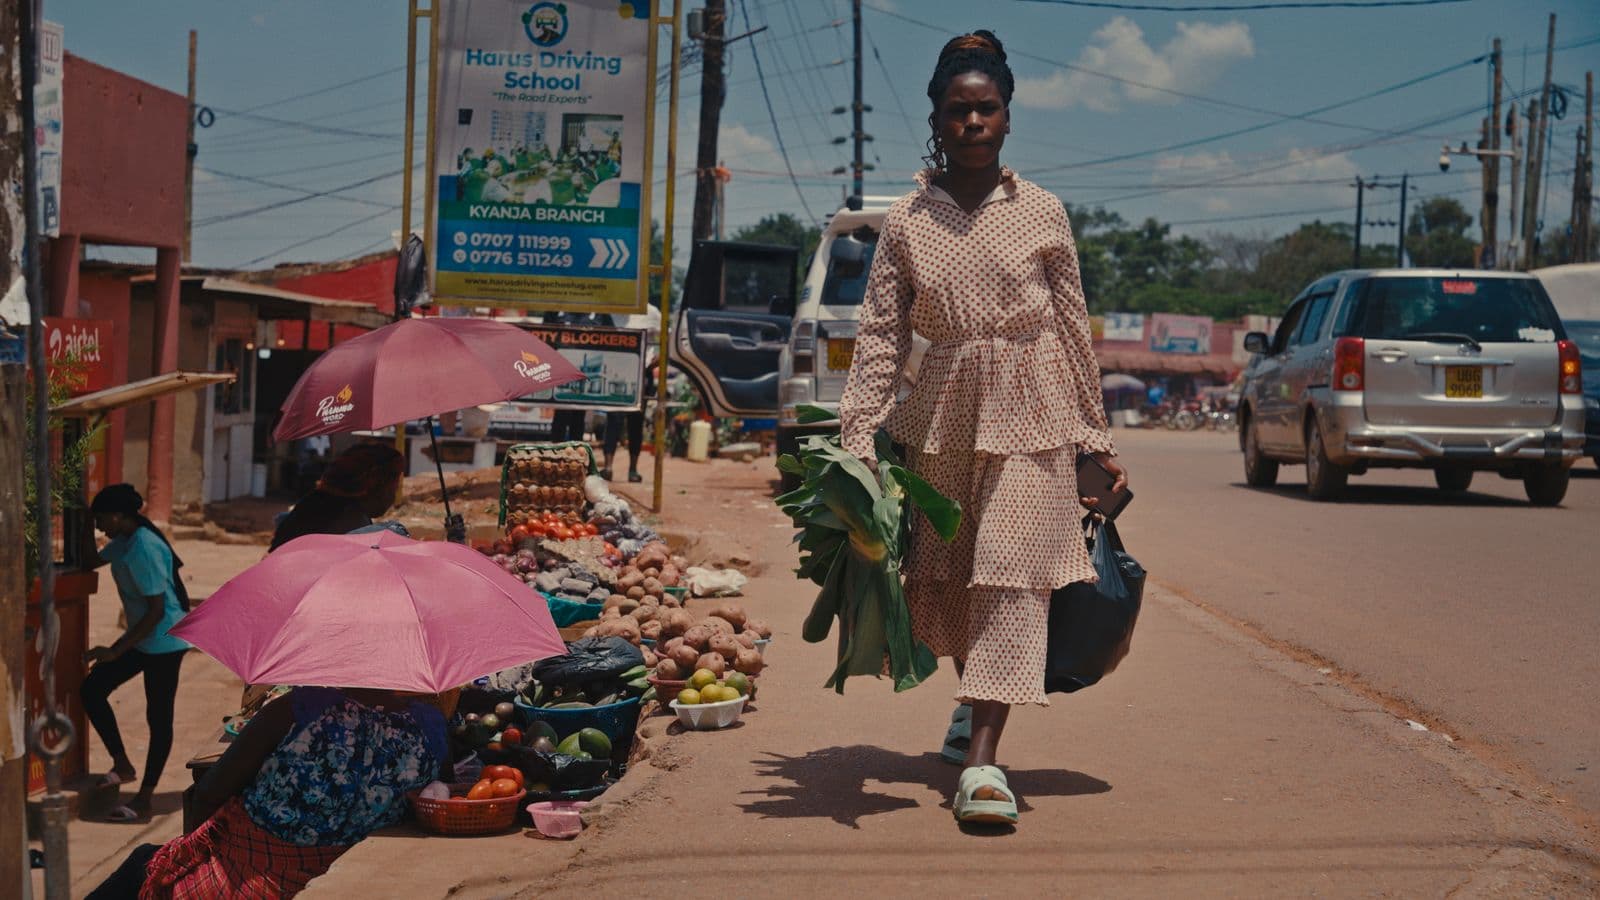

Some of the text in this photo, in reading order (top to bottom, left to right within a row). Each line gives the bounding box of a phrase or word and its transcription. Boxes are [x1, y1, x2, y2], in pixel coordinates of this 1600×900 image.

[466, 48, 622, 75] Harus Driving
[504, 71, 580, 91] School
[492, 92, 592, 106] "The Road Experts"
[469, 204, 605, 224] KYANJA BRANCH
[470, 232, 571, 250] 0707 111999
[470, 250, 573, 268] 0776 511249
[65, 324, 101, 362] airtel
[561, 333, 637, 347] BLOCKERS
